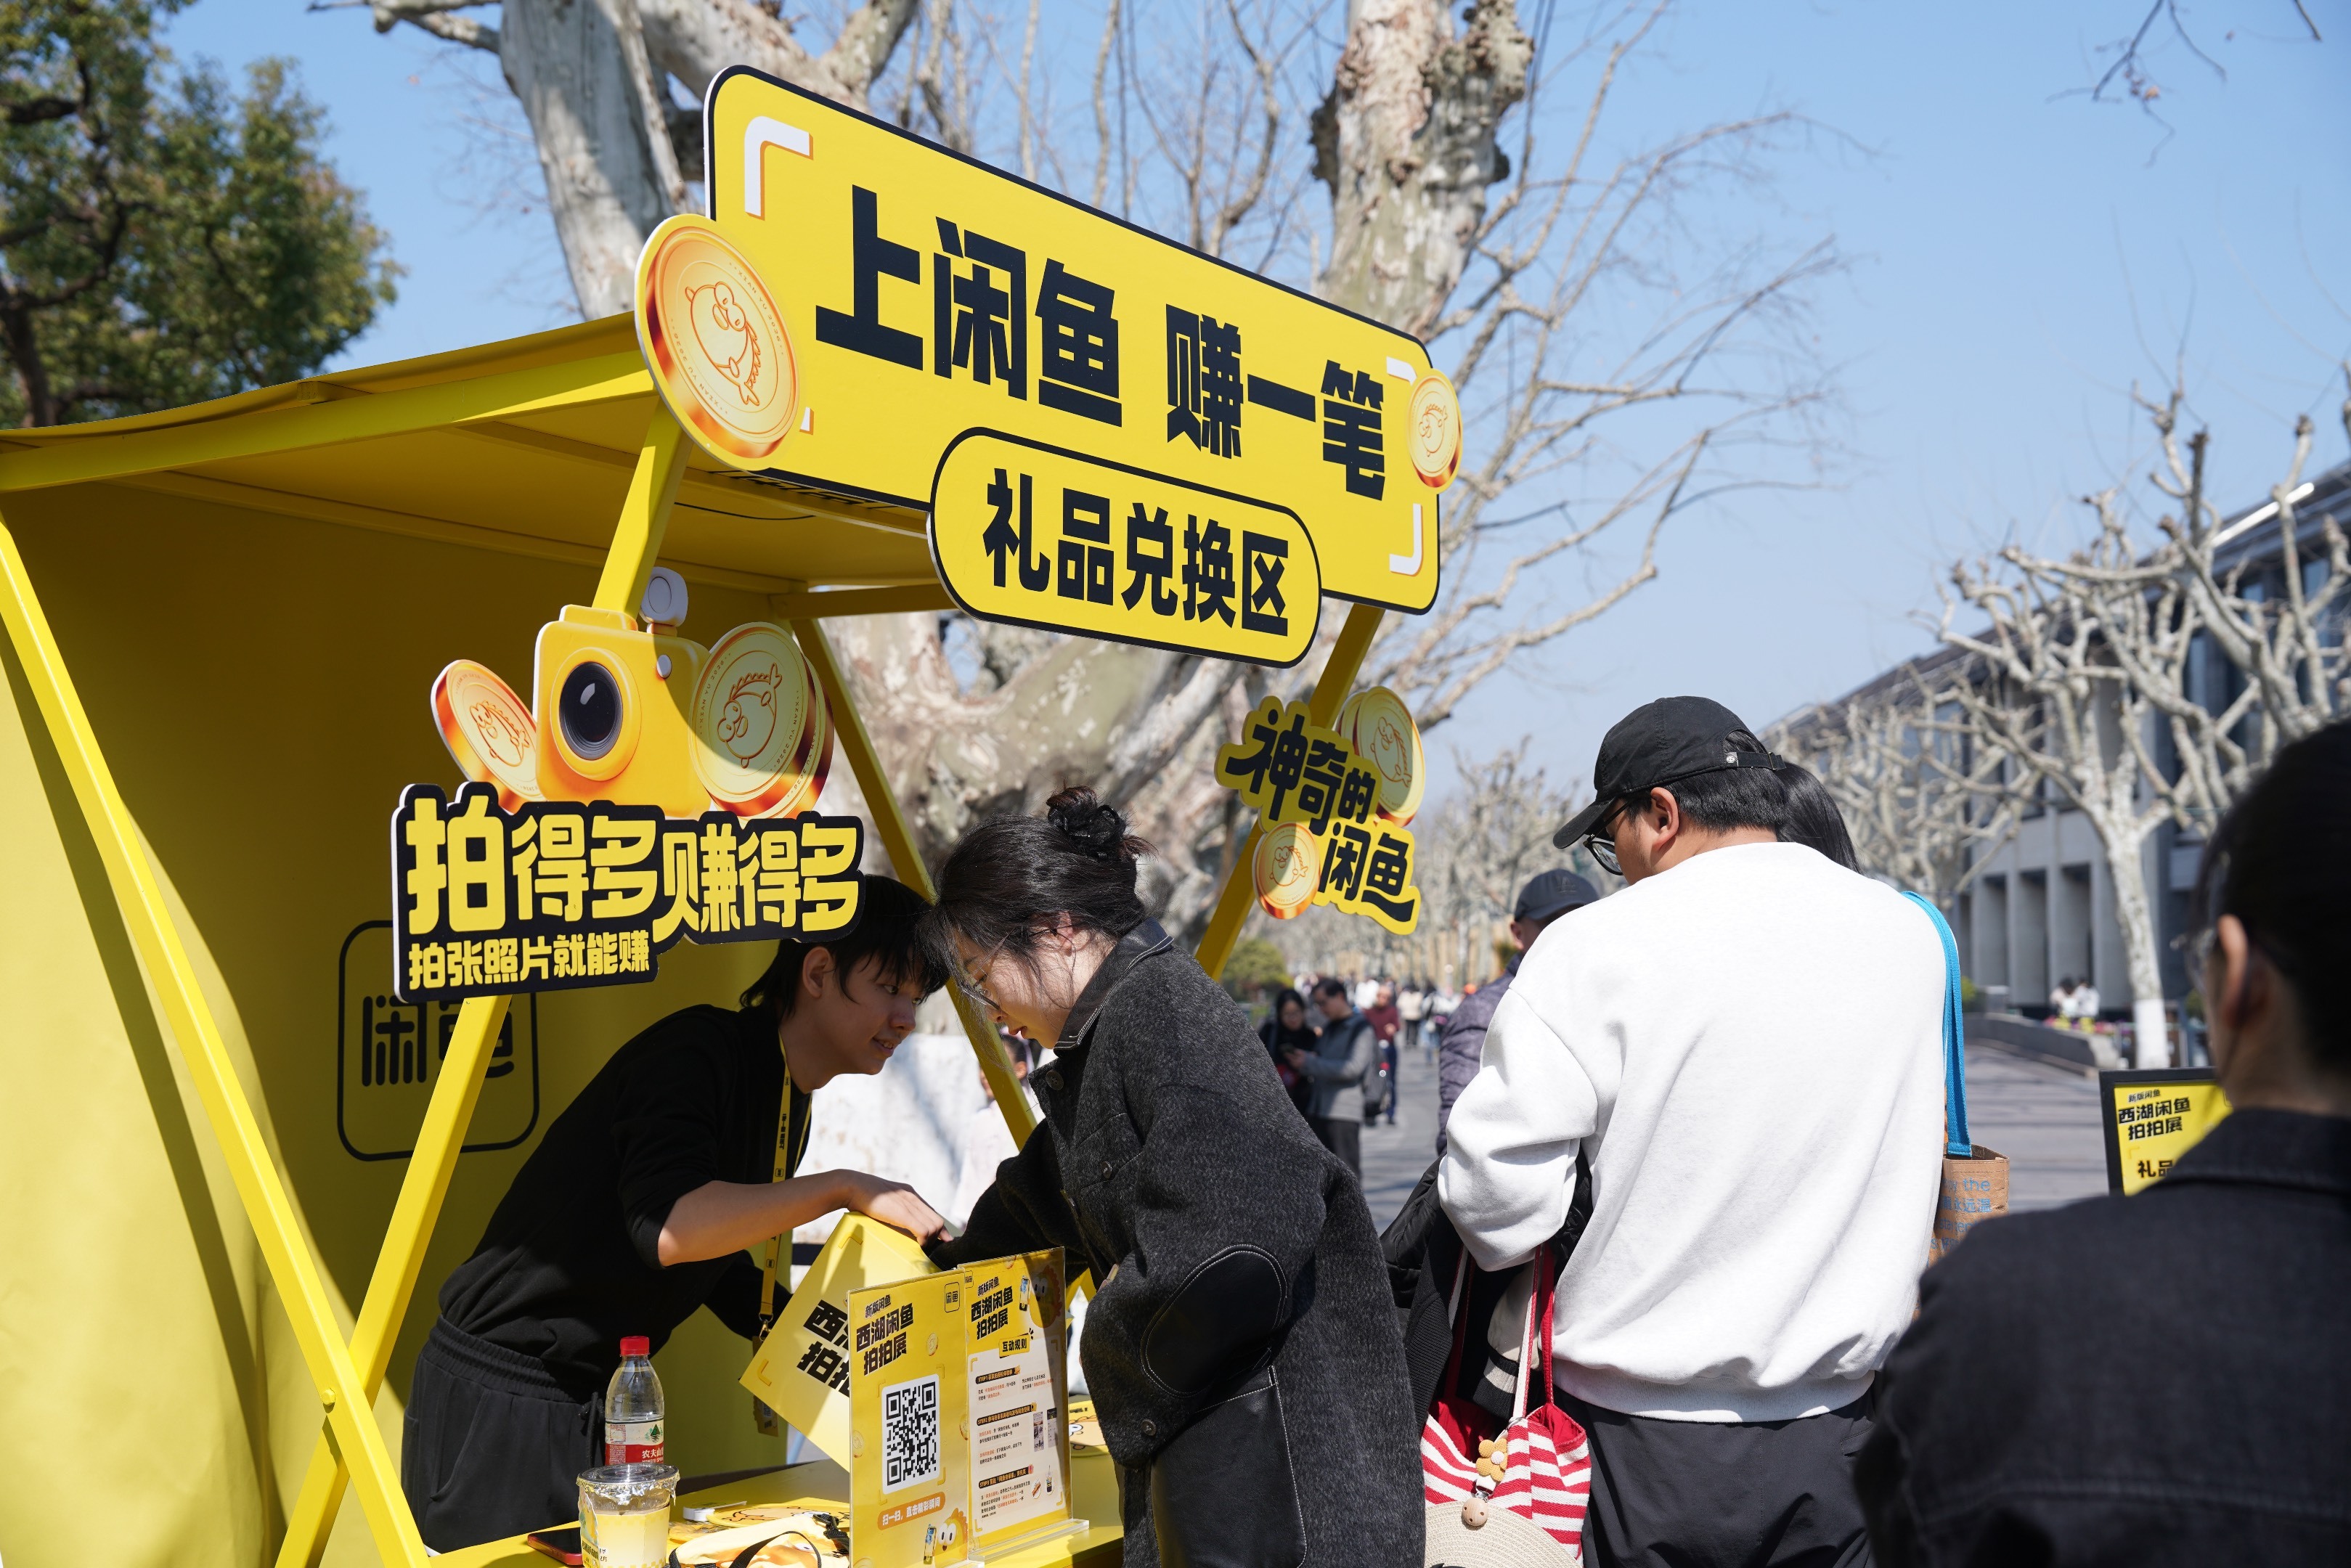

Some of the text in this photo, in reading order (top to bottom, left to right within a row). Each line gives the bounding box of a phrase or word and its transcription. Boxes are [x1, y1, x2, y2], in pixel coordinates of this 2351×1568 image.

[738, 271, 757, 293] XIAN
[759, 297, 767, 310] YU
[816, 184, 1385, 501] 上闲鱼 赚一笔
[982, 467, 1289, 637] 礼品兑换区
[1225, 709, 1376, 836] 神奇的
[406, 796, 858, 944] 拍得多赚得多
[1318, 822, 1415, 922] 闲鱼
[409, 930, 649, 990] 拍张照片就能赚
[2118, 1097, 2191, 1124] 西湖闲鱼
[2128, 1089, 2161, 1103] 新版闲鱼
[2128, 1116, 2183, 1140] 拍拍展
[1963, 1177, 1991, 1192] the
[945, 1291, 958, 1304] 闲鱼
[971, 1286, 1014, 1322] 西湖闲鱼
[977, 1276, 1000, 1297] 新版闲鱼
[865, 1294, 891, 1318] 新版闲鱼
[977, 1307, 1009, 1340] 拍拍展
[803, 1299, 849, 1351] 西
[857, 1303, 913, 1352] 西湖闲鱼
[864, 1331, 907, 1376] 拍拍展
[1002, 1337, 1027, 1352] 互动规则
[882, 1497, 940, 1526] 扫一扫，直击精彩瞬间
